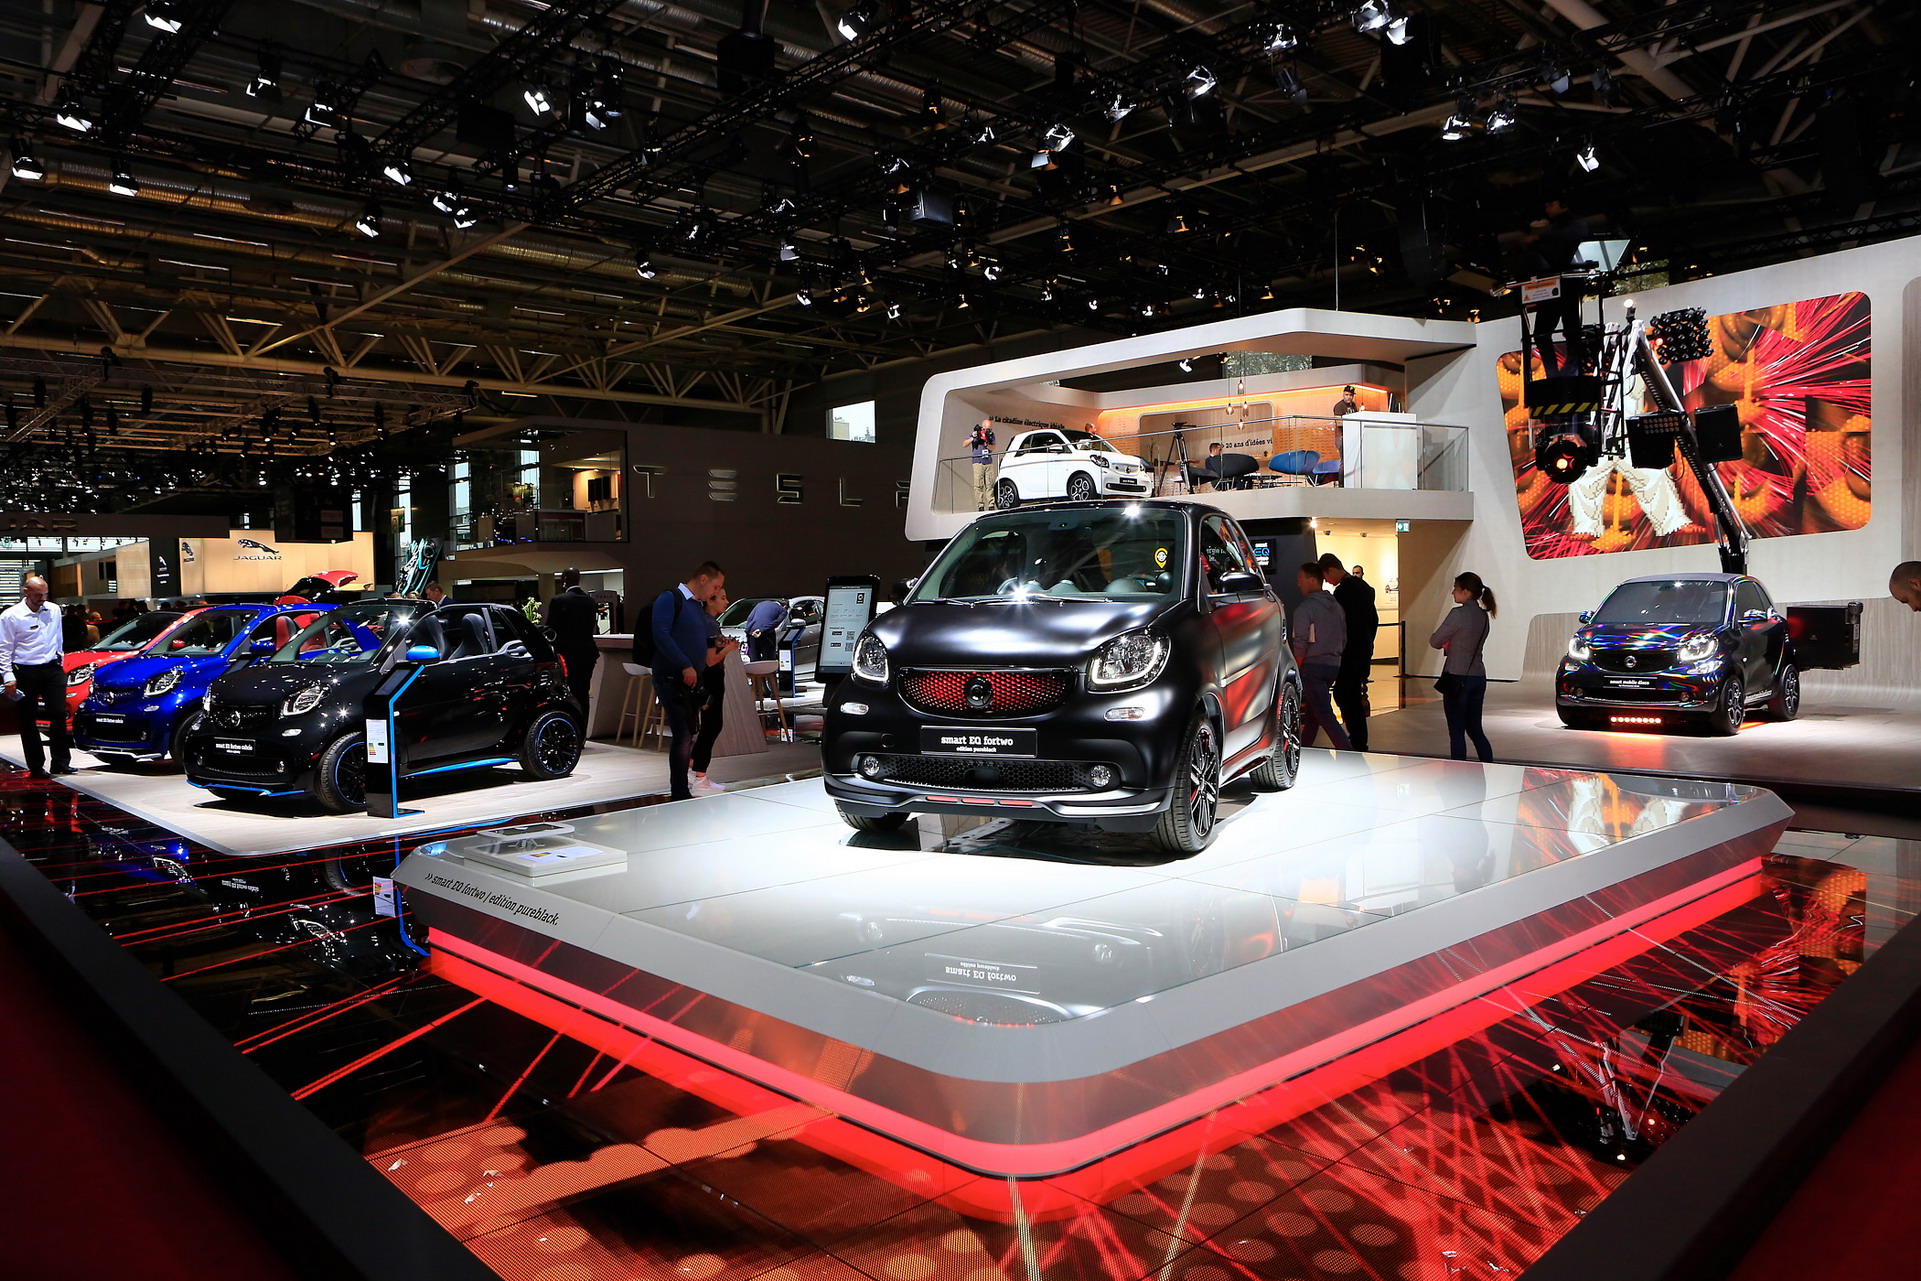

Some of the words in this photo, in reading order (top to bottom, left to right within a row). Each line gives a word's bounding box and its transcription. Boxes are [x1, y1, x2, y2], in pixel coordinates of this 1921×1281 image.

[994, 415, 1001, 423] La
[1253, 547, 1270, 557] EQ
[941, 736, 967, 745] smart
[969, 736, 982, 745] EQ
[983, 736, 1013, 746] fortwo
[431, 875, 451, 889] smart
[451, 878, 462, 891] EQ
[461, 881, 486, 899] fortwo
[489, 893, 517, 911] edition
[515, 903, 559, 926] pureblack.
